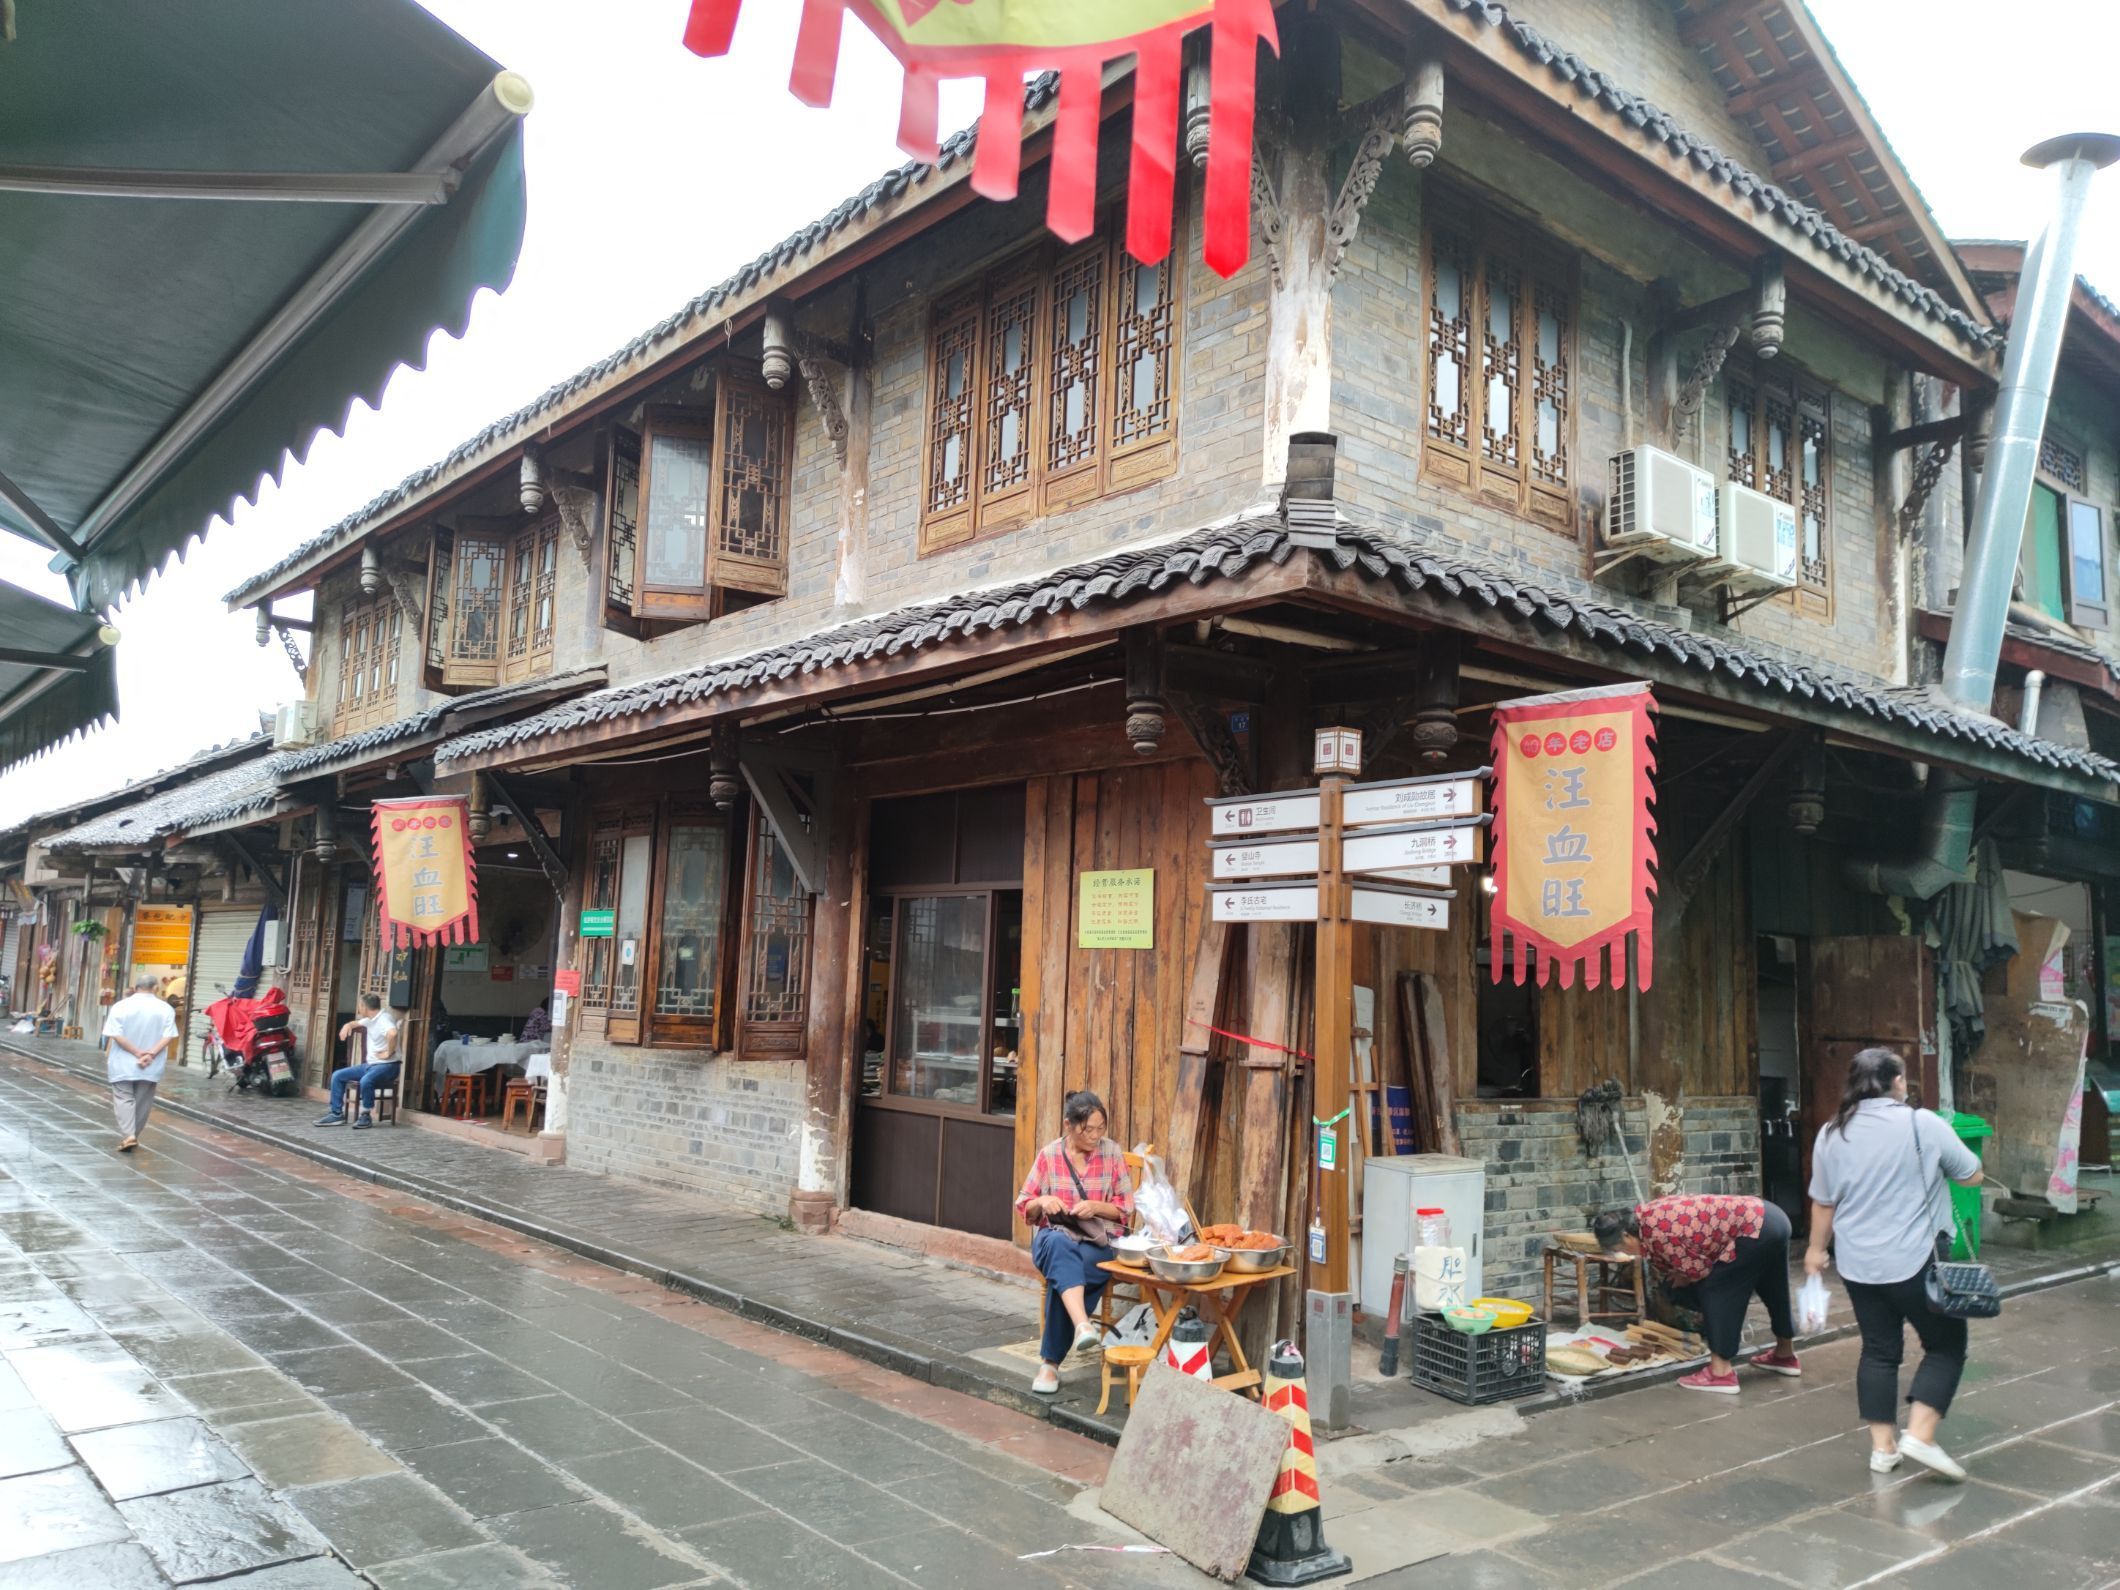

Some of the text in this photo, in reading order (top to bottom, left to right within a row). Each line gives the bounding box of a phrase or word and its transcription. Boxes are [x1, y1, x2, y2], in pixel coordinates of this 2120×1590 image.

[1256, 805, 1276, 816] 卫生间
[1541, 765, 1592, 918] 汪血旺
[410, 835, 444, 917] 汪血旺
